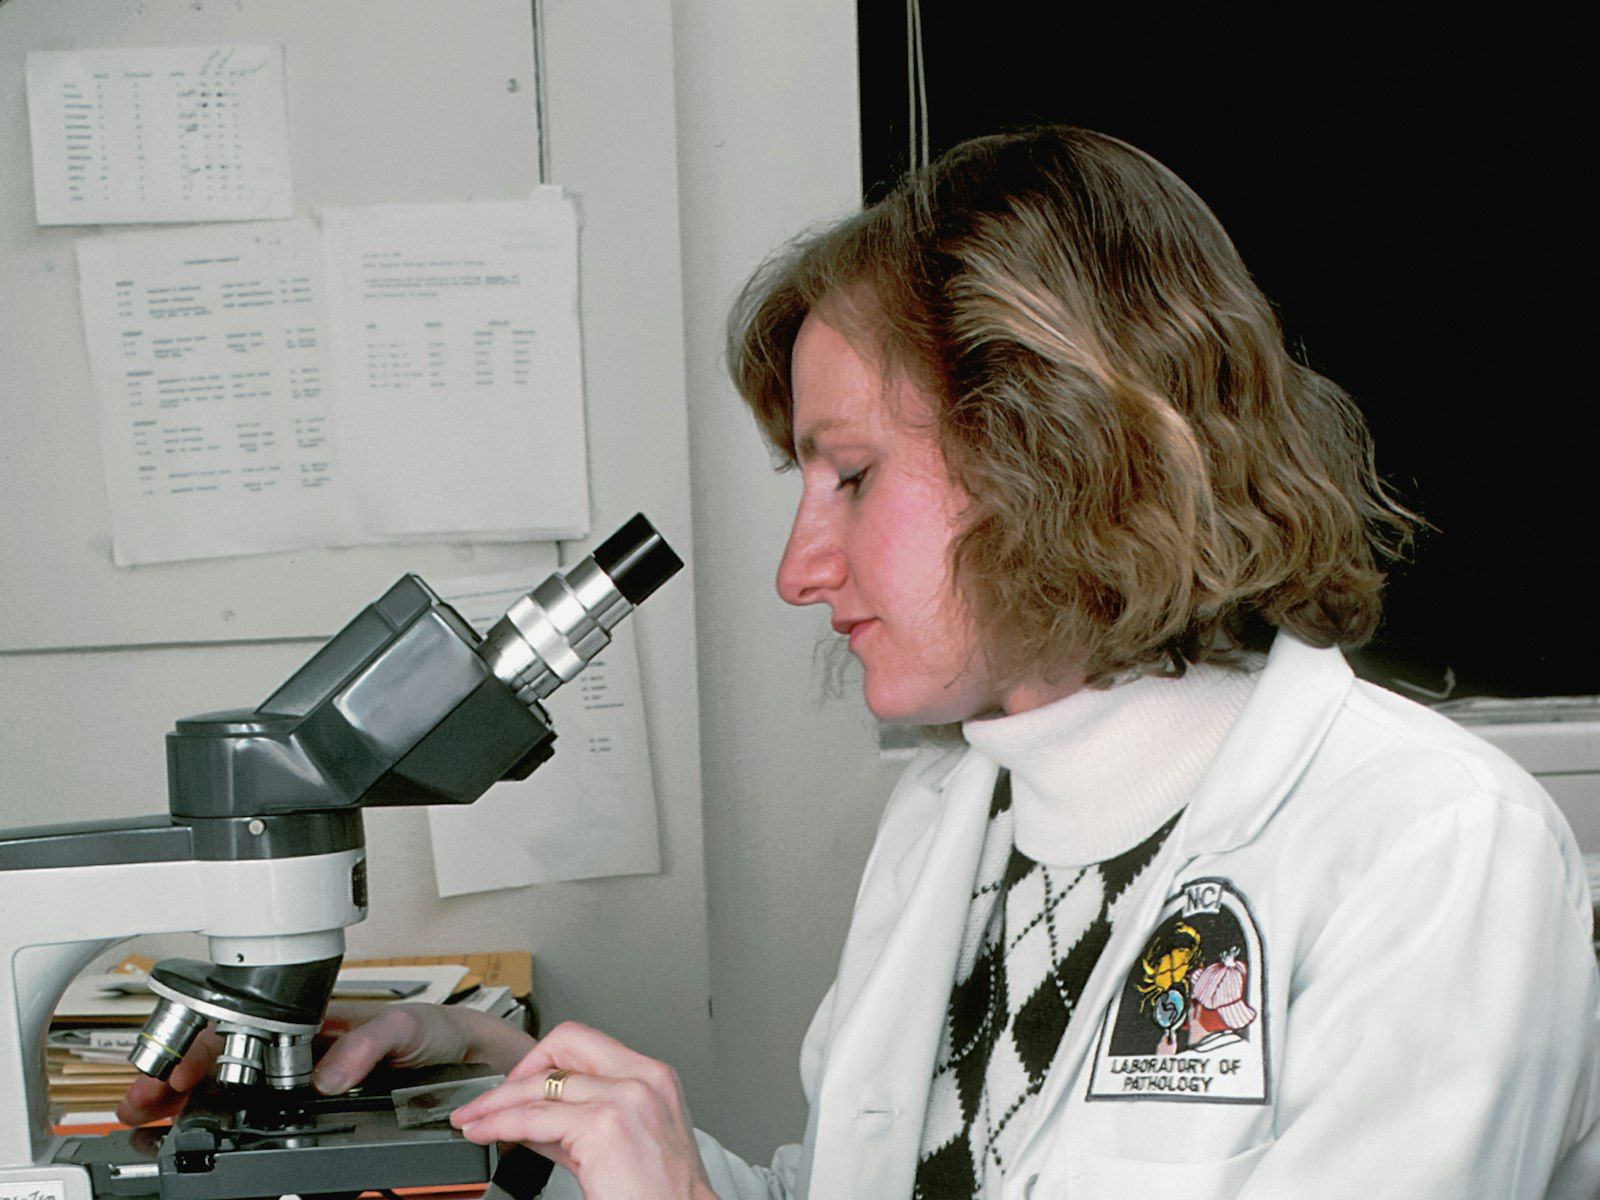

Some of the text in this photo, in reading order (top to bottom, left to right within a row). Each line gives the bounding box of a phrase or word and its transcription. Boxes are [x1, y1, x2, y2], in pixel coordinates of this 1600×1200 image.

[1187, 886, 1223, 912] NCI
[1111, 1058, 1242, 1075] LABORATORY OF
[1123, 1077, 1214, 1093] PATHOLOGY
